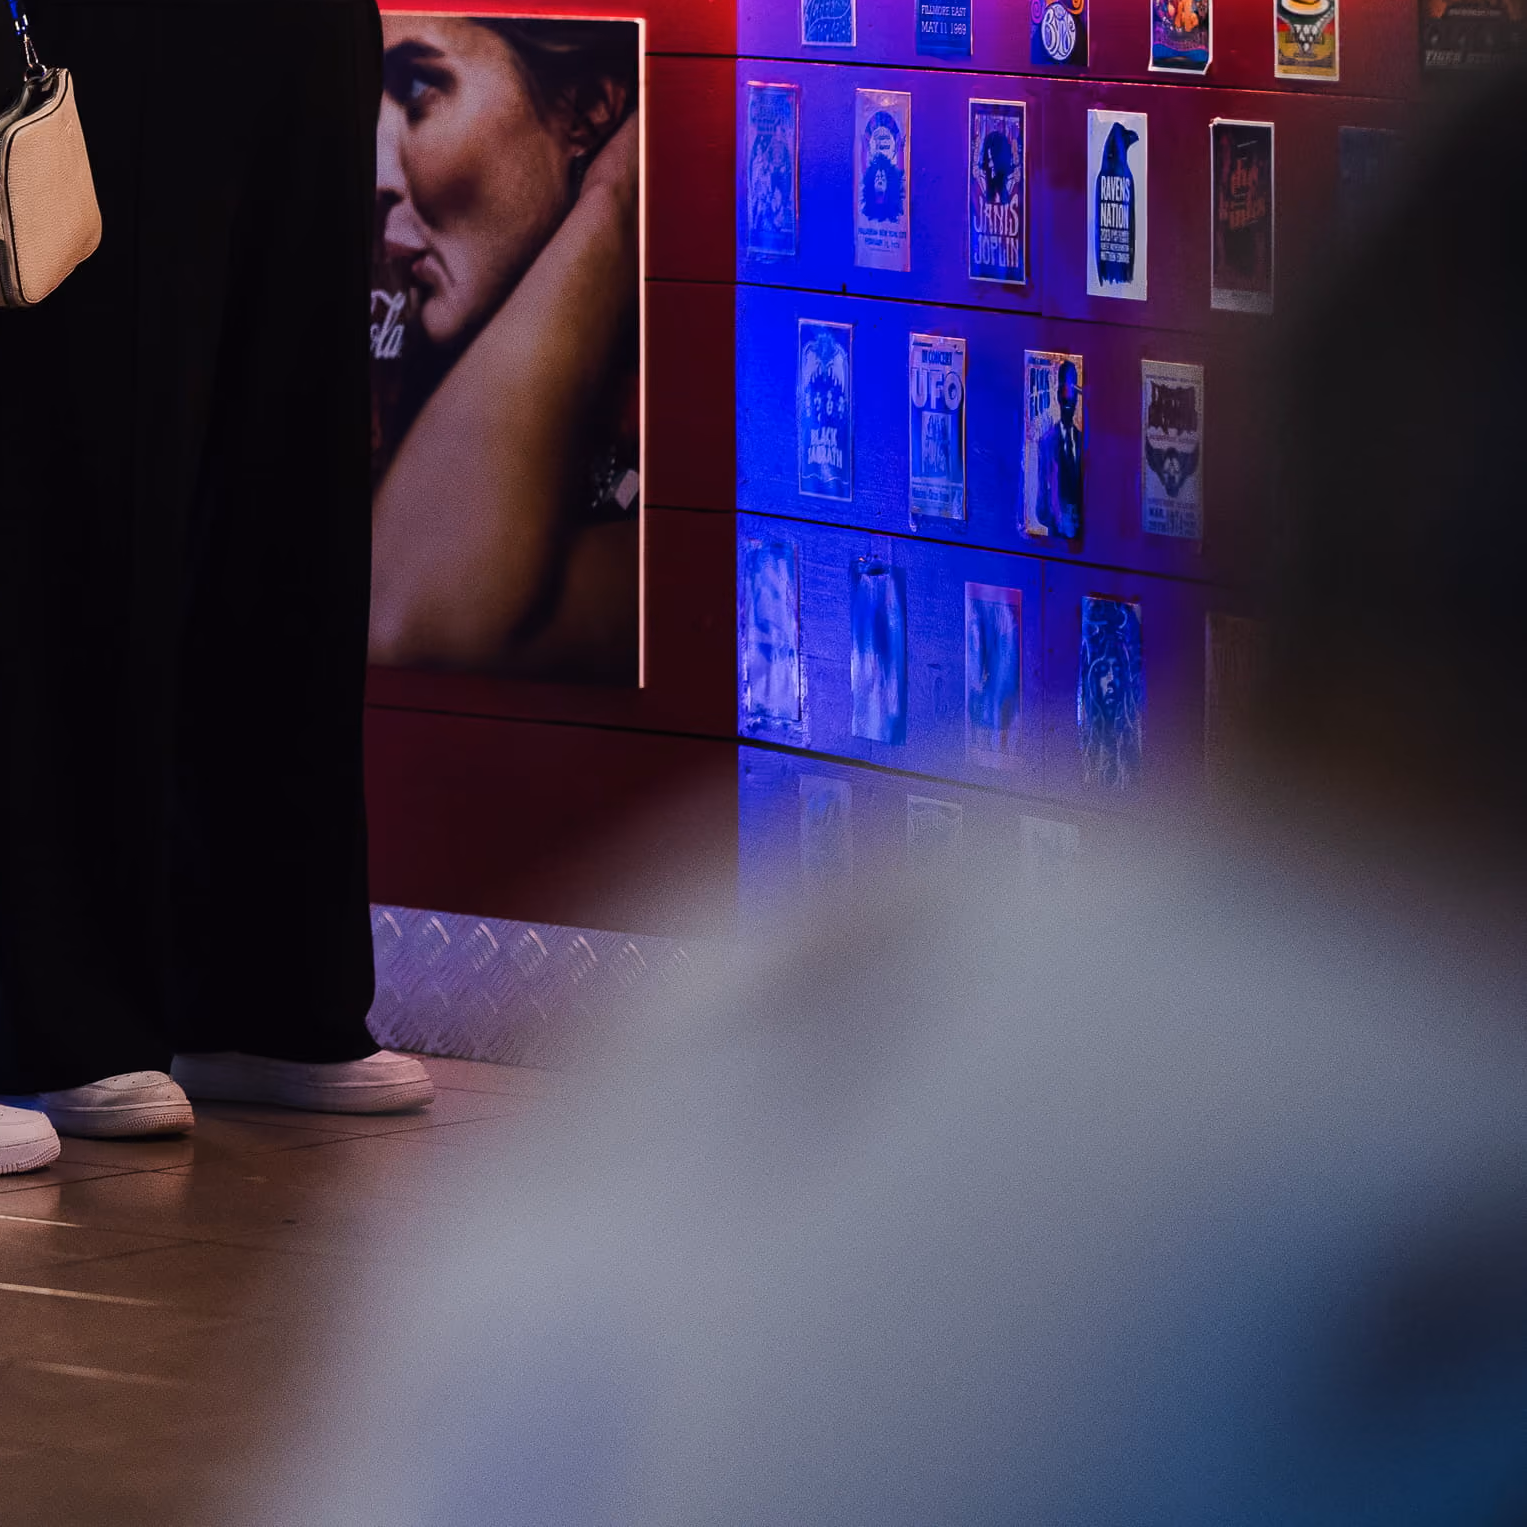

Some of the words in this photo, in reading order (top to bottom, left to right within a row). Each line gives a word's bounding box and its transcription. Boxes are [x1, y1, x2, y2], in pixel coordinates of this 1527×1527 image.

[951, 7, 967, 17] EAST
[921, 21, 939, 33] MAY
[1100, 175, 1131, 203] RAVENS
[973, 195, 1019, 236] JANIS
[1100, 202, 1129, 229] NATION
[974, 236, 1019, 268] JOPLIN
[911, 366, 963, 411] UFO
